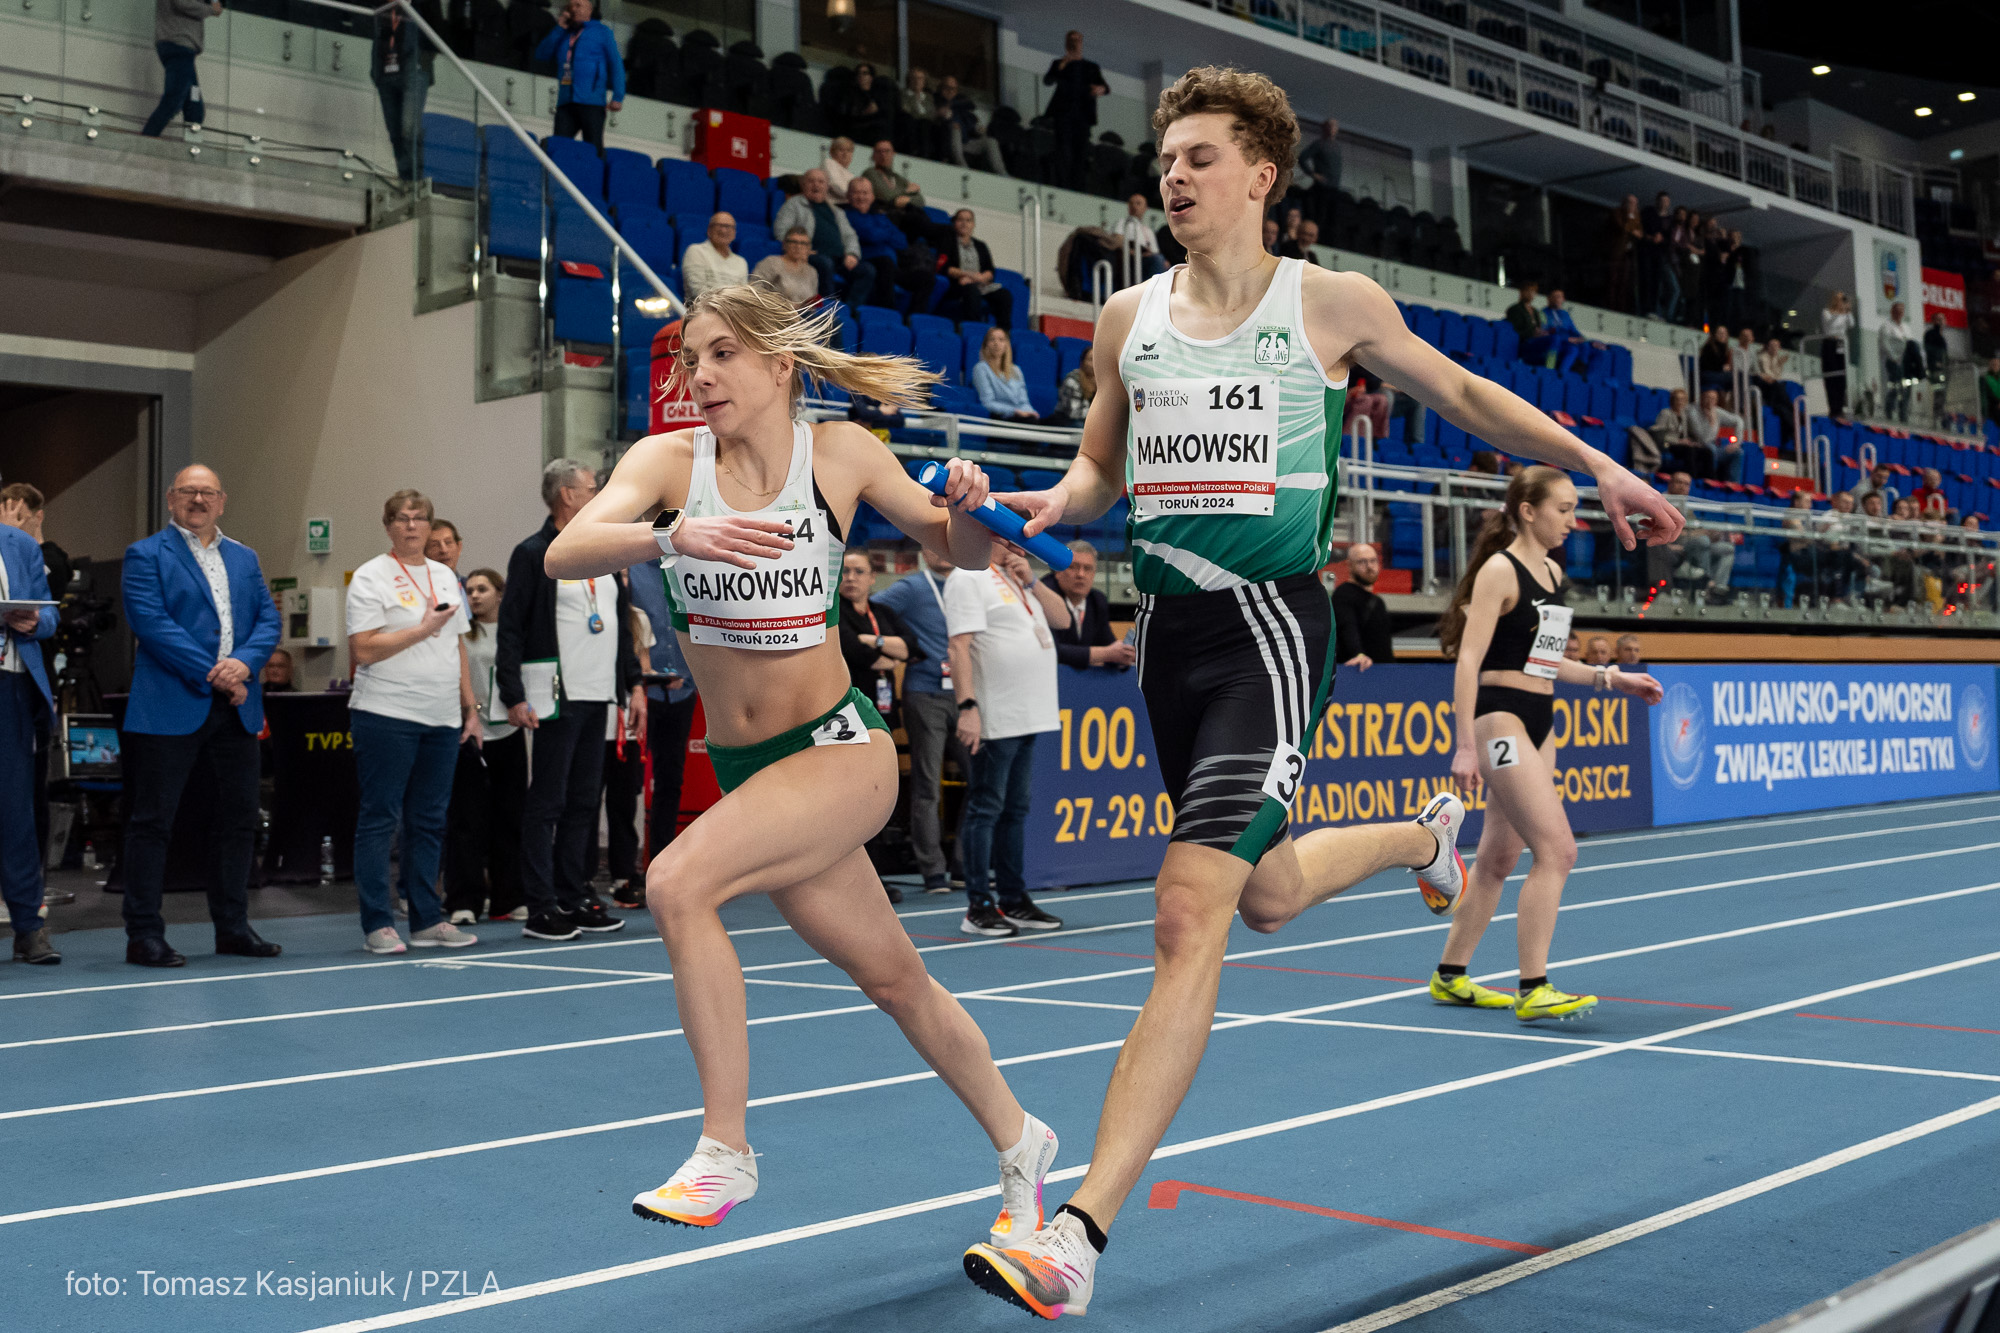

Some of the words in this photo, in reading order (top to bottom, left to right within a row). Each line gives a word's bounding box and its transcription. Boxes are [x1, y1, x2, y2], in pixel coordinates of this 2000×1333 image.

[1135, 353, 1160, 362] erima
[667, 403, 703, 418] ORL
[1148, 393, 1190, 408] TORUŃ
[1208, 384, 1264, 411] 161
[1137, 433, 1269, 466] MAKOWSKI
[1137, 485, 1147, 493] 68.
[1147, 485, 1161, 493] PZLA
[1162, 484, 1190, 492] Halowe
[1191, 482, 1242, 491] Mistrzostwa
[1243, 483, 1270, 493] Polski
[1158, 495, 1199, 510] TORUŃ
[1202, 498, 1235, 508] 2024
[684, 567, 824, 601] GAJKOWSKA
[693, 615, 705, 624] 68.
[705, 617, 721, 626] PZLA
[721, 620, 751, 629] Halowe
[752, 618, 803, 629] Mistrzostwa
[804, 613, 823, 624] Polski
[720, 632, 762, 645] TORUŃ
[765, 633, 799, 645] 2024
[1712, 680, 1952, 726] KUJAWSKO-POMORSKI
[824, 713, 857, 741] 2
[1059, 706, 1147, 771] 100.
[1307, 701, 1456, 760] ISTRZOS
[1552, 698, 1629, 748] OLSKI
[305, 731, 344, 751] TVP
[1494, 740, 1513, 766] 2
[1714, 741, 1807, 792] ZWIĄZEK
[1809, 738, 1878, 778] LEKKIEJ
[1881, 736, 1955, 774] ATLETYKI
[1277, 754, 1303, 803] 3
[1552, 764, 1632, 802] GOSZCZ
